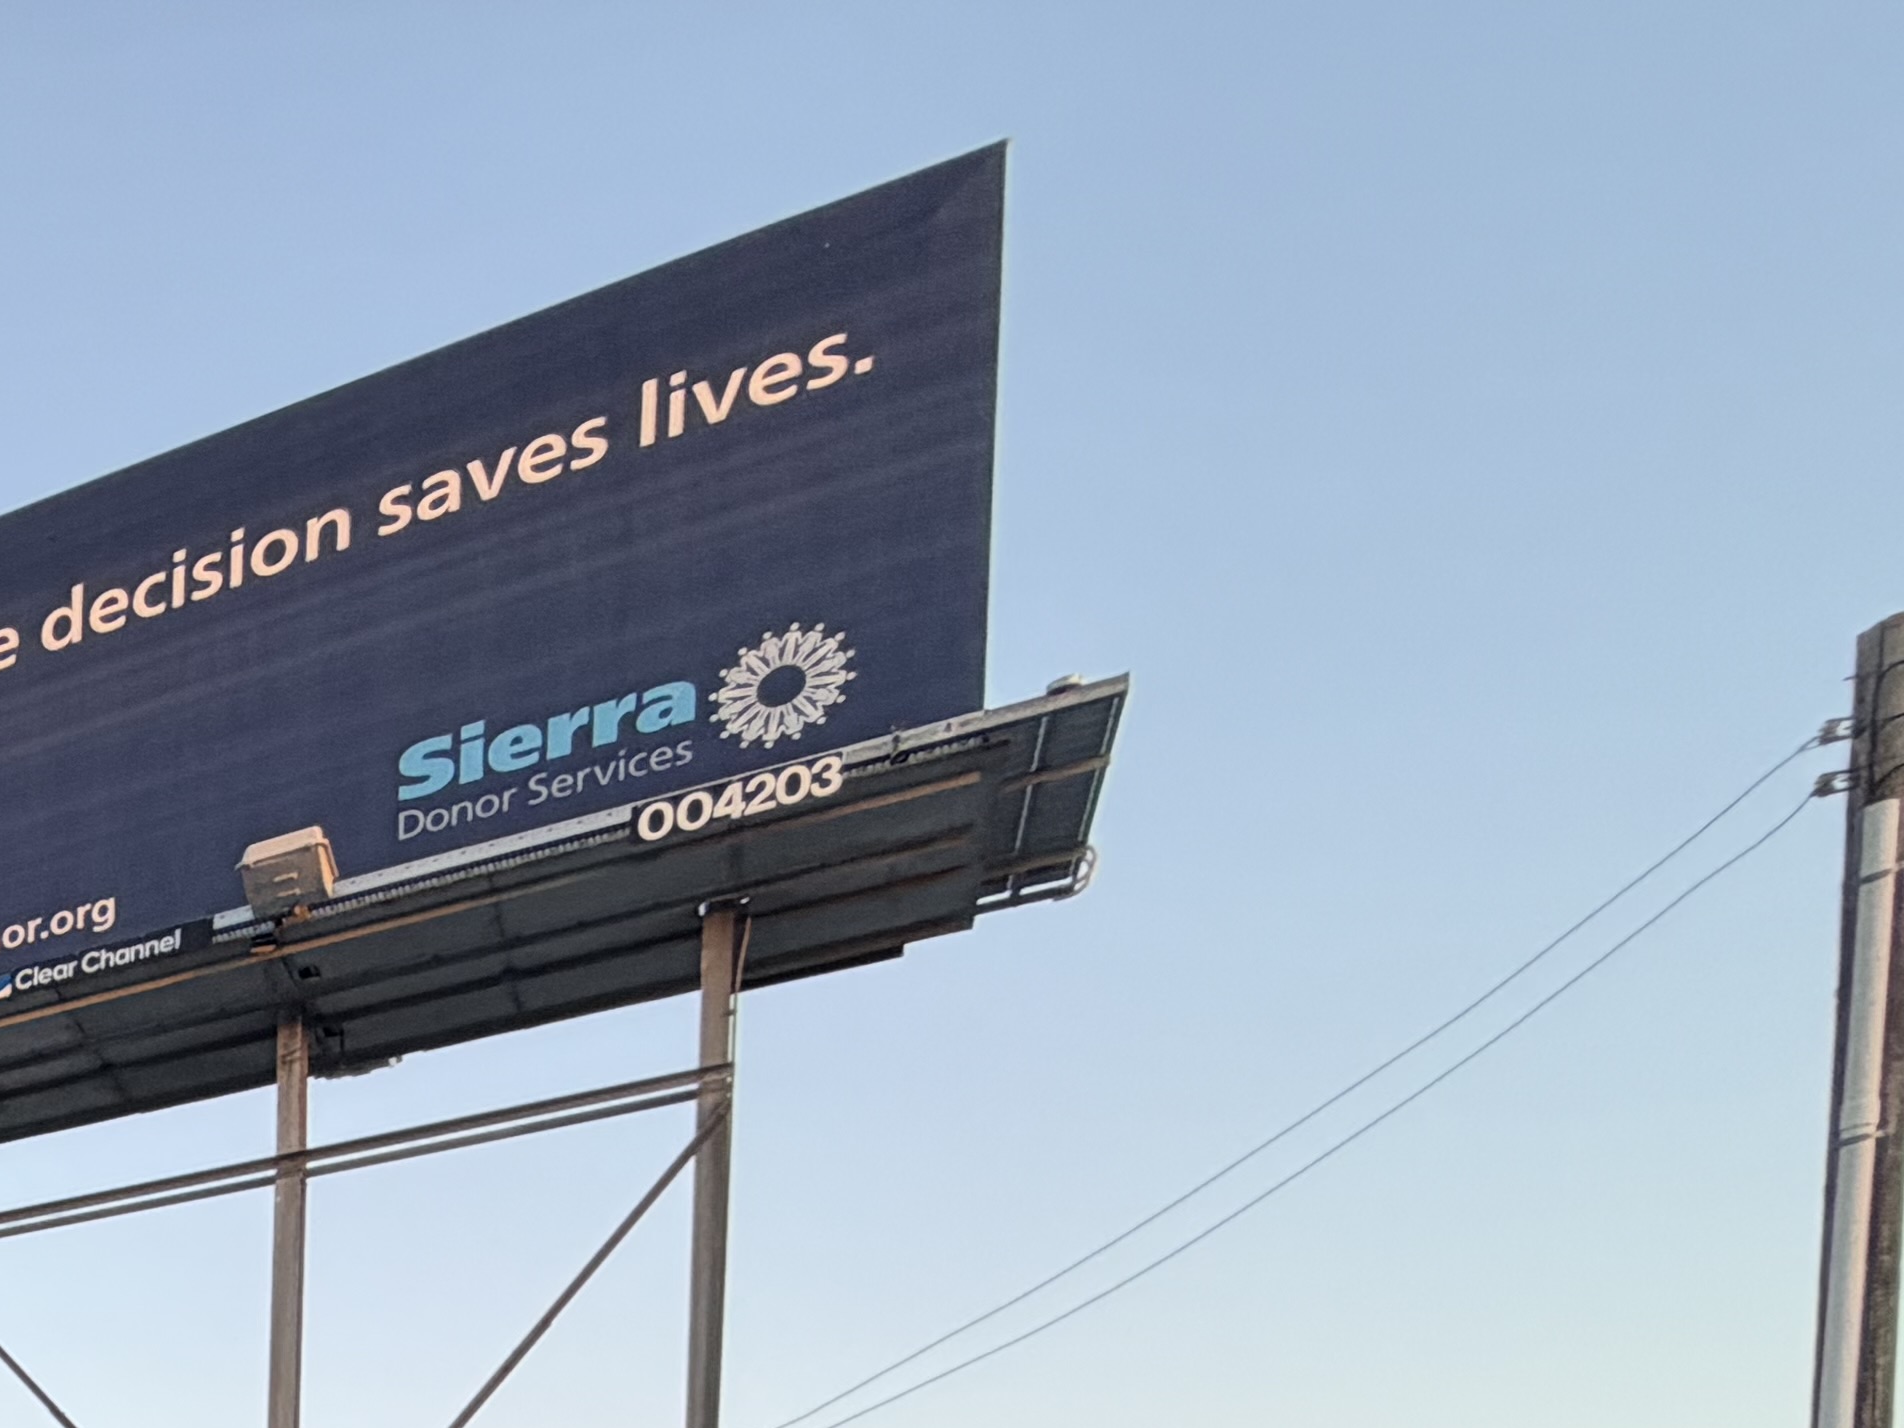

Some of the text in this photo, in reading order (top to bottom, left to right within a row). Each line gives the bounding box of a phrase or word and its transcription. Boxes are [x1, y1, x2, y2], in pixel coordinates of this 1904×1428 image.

[41, 507, 351, 651] decision
[377, 415, 609, 537] saves
[639, 332, 875, 447] lives.
[397, 680, 697, 800] Sierra
[397, 740, 693, 841] Donor Services
[636, 757, 843, 842] 004203
[14, 928, 182, 991] Clear Channel
